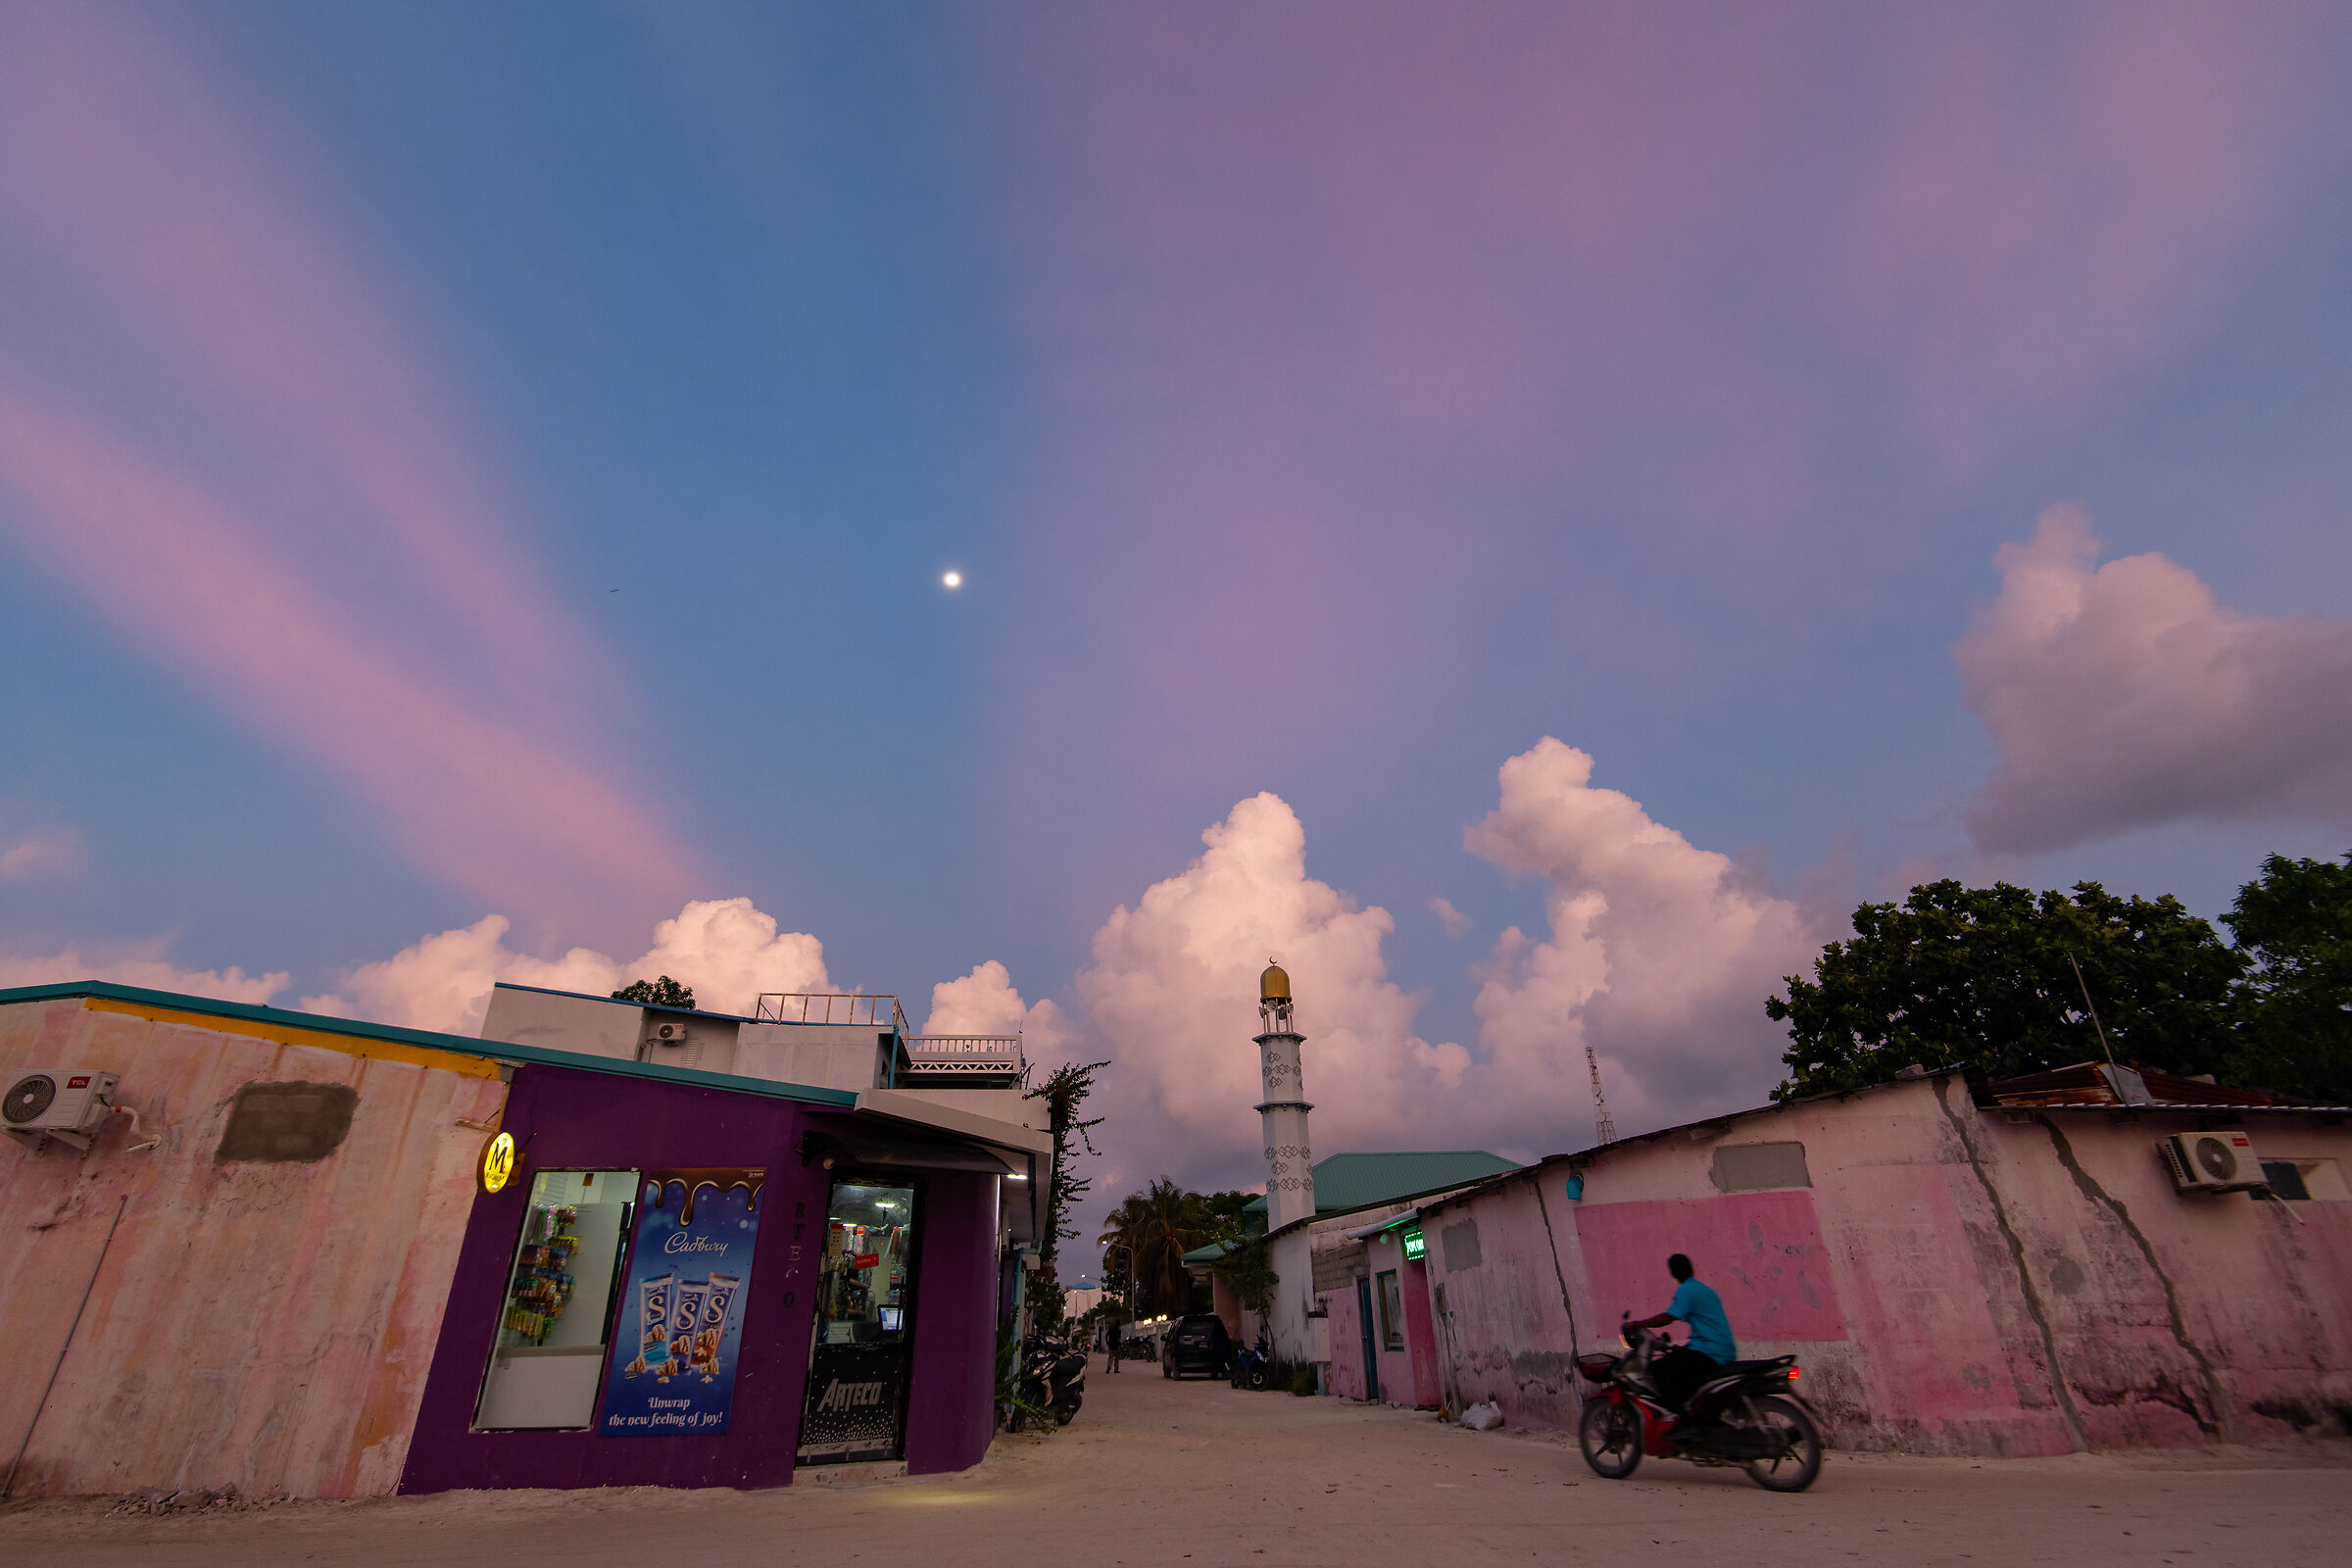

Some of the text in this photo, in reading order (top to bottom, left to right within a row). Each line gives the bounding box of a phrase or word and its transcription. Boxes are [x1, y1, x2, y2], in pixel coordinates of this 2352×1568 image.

[489, 1142, 508, 1173] M
[664, 1231, 729, 1257] Cadbury
[648, 1396, 691, 1410] Unwrap
[816, 1378, 883, 1411] ARTECO
[609, 1411, 723, 1428] the new feeling of joy!
